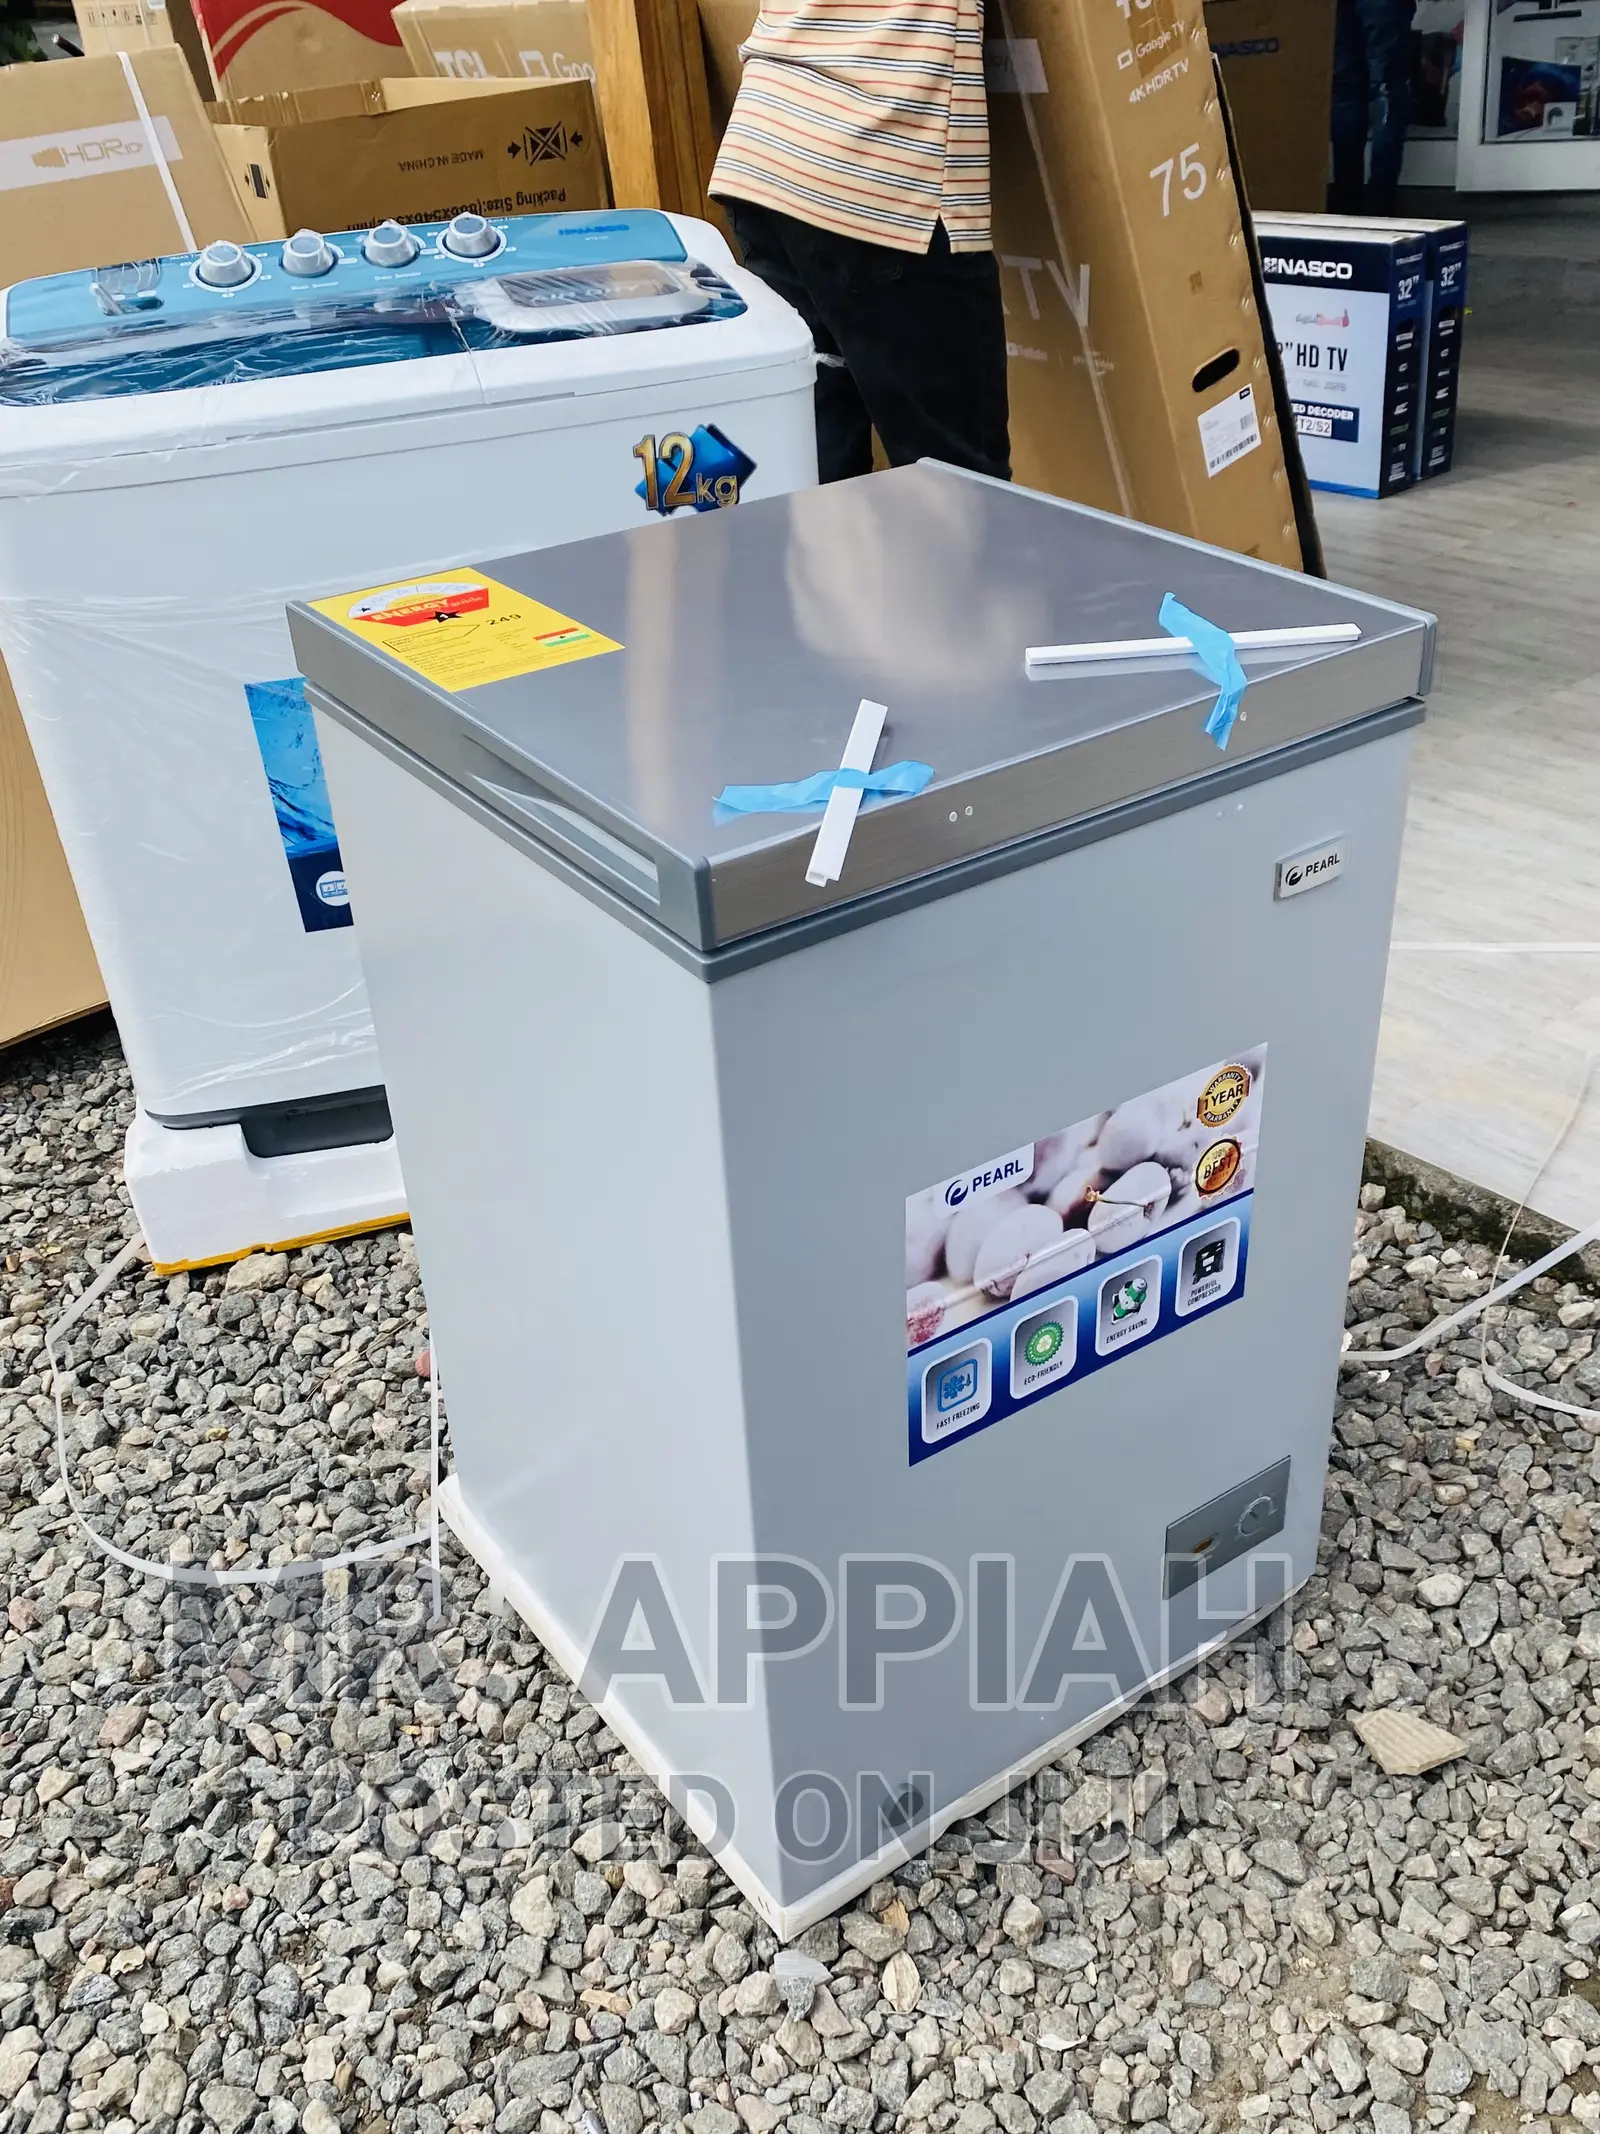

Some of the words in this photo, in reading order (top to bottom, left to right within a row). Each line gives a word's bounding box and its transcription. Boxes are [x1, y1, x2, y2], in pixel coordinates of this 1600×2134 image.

[1136, 30, 1171, 57] Google
[1171, 18, 1185, 38] TV
[1129, 85, 1146, 104] 4K
[1146, 69, 1173, 95] HDR
[1171, 57, 1189, 78] TV
[398, 155, 435, 172] CHINA
[436, 153, 450, 167] IN
[452, 149, 484, 164] MADE
[1149, 142, 1207, 217] 75
[516, 188, 567, 207] Packing
[1277, 258, 1353, 280] NASCO
[1296, 343, 1320, 368] HD
[1327, 346, 1348, 372] TV
[1307, 405, 1354, 420] DECODER
[371, 599, 449, 620] ENERGY
[1304, 853, 1341, 878] PEARL
[1207, 1071, 1244, 1094] WARRANTY
[1211, 1083, 1244, 1107] YEAR
[972, 1159, 1024, 1192] PEARL
[1203, 1153, 1234, 1180] BEST
[1187, 1284, 1222, 1307] COMPRESSOR
[1190, 1279, 1218, 1297] POWERFUL
[1106, 1329, 1128, 1344] ENERGY
[1128, 1318, 1148, 1333] SAVING
[1023, 1360, 1064, 1386] ECO-FRIENDLY
[936, 1415, 951, 1430] FAST
[952, 1402, 981, 1422] FREEZING
